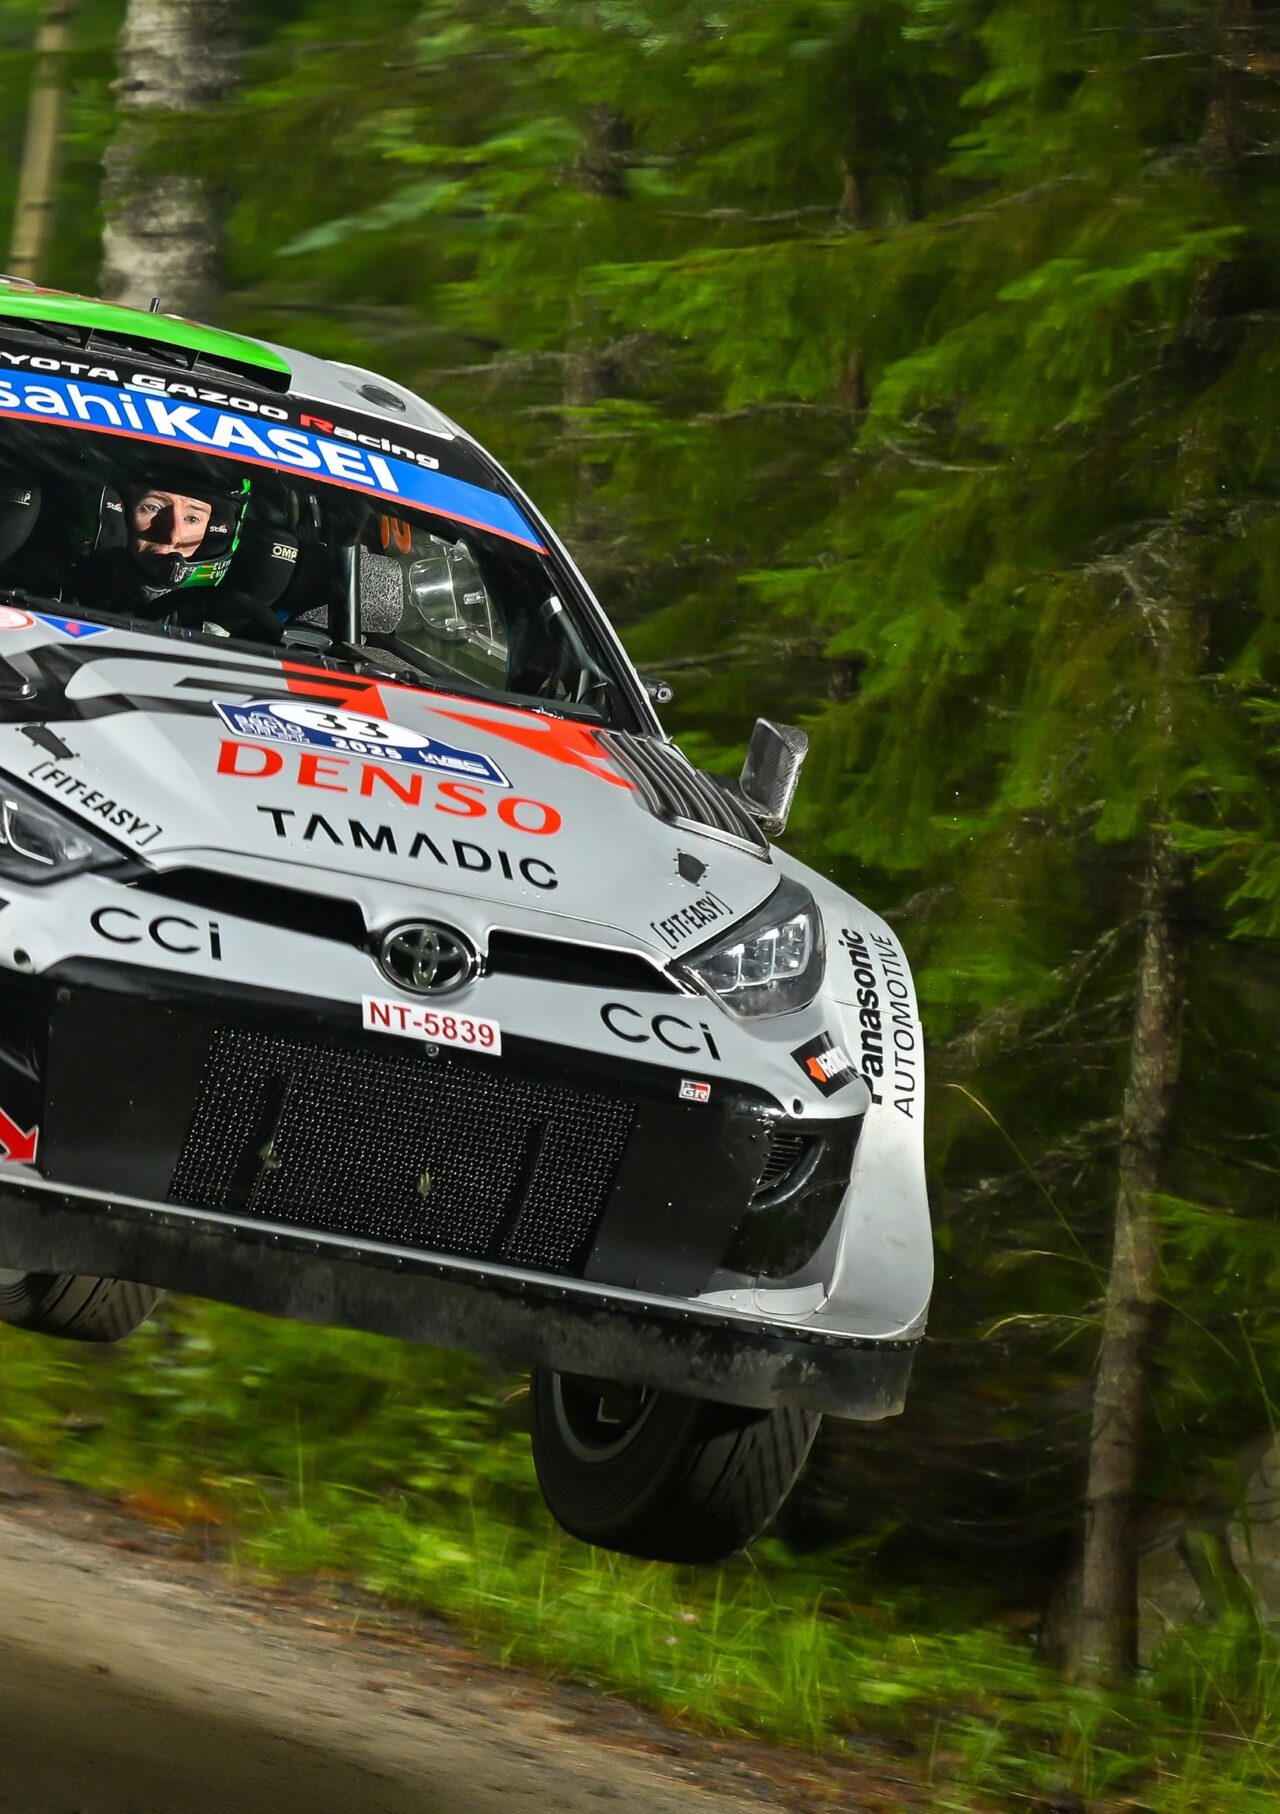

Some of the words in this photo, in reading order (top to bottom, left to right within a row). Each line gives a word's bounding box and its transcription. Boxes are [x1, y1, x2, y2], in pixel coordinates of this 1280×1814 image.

[131, 373, 289, 421] GAZOO
[300, 414, 440, 470] Racing
[271, 544, 299, 562] OMP
[305, 708, 390, 740] 33
[330, 735, 403, 761] 2025
[216, 739, 563, 837] DENSO
[256, 805, 560, 890] TAMADIC
[369, 1000, 496, 1049] NT-5839
[869, 932, 916, 1119] AUTOMOTIVE
[681, 1079, 711, 1102] GR
